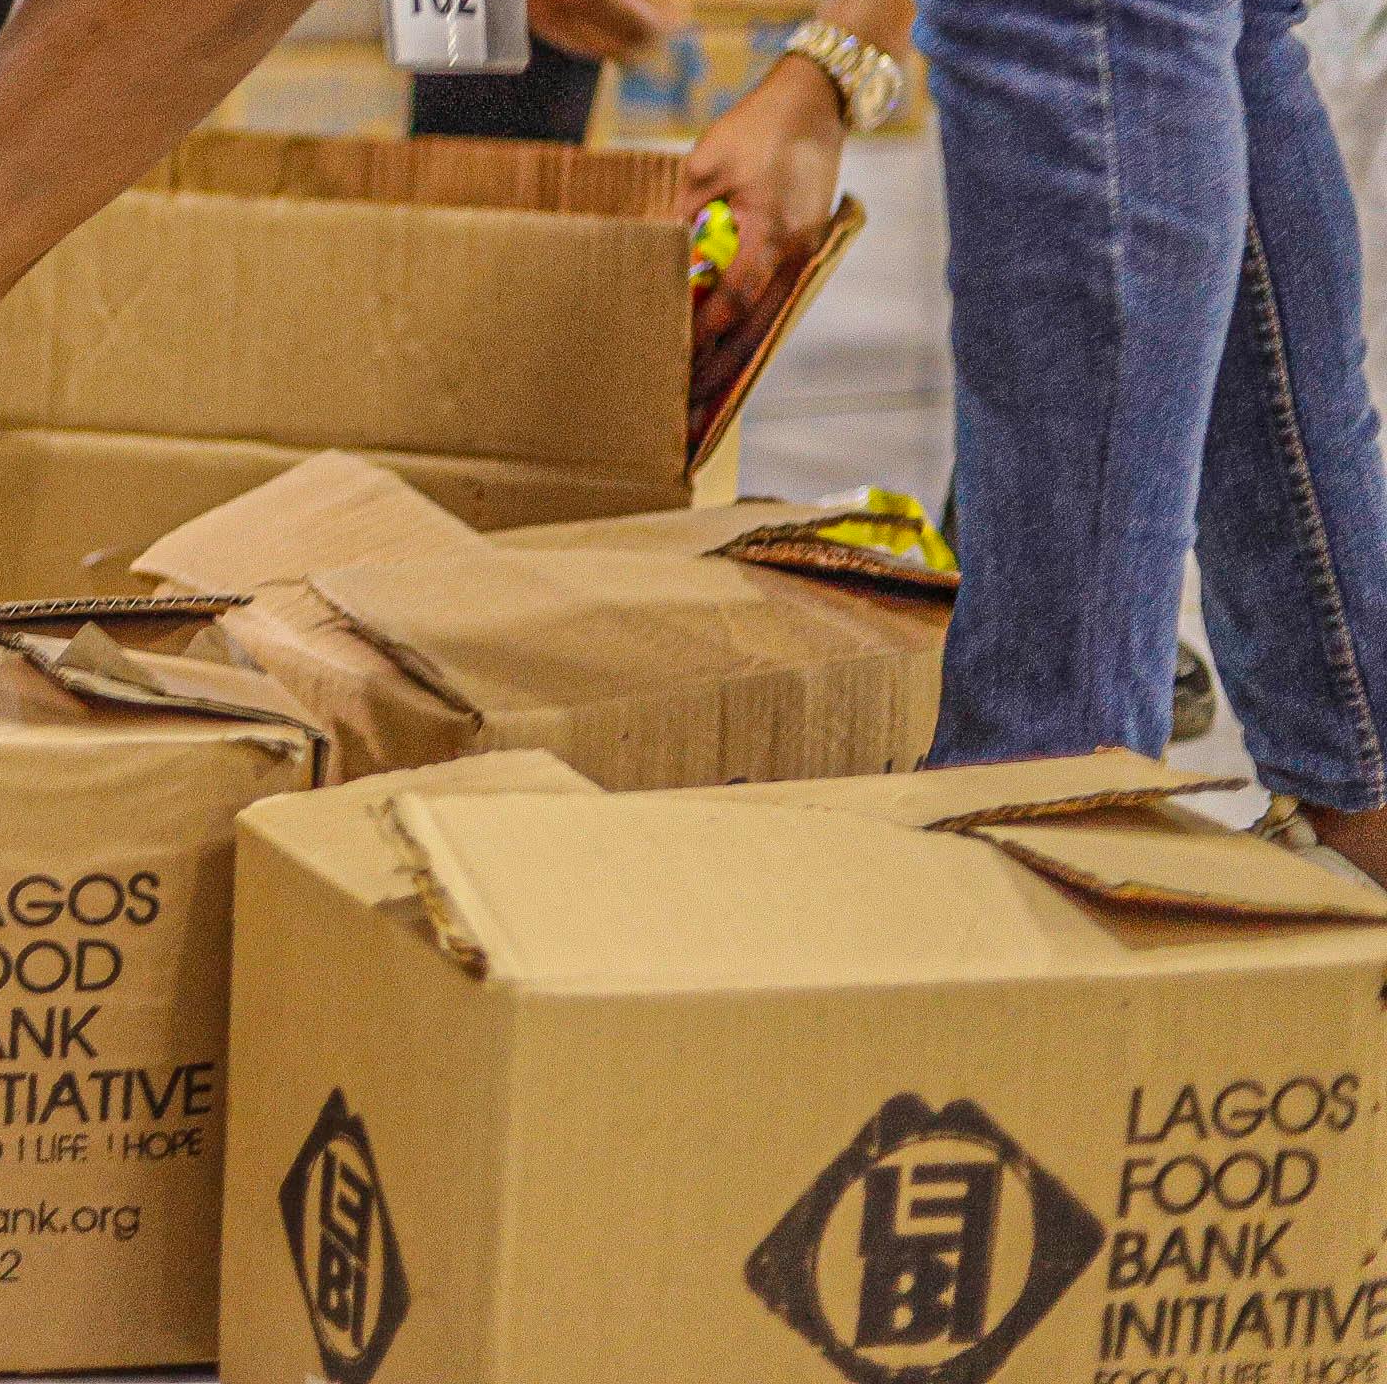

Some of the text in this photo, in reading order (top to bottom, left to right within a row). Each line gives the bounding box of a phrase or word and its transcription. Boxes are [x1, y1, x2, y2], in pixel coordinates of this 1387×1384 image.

[121, 1124, 204, 1162] HOPE
[1125, 1071, 1361, 1146] LAGOS
[1115, 1147, 1320, 1220] FOOD
[1106, 1218, 1293, 1291] BANK
[1098, 1276, 1387, 1362] INITIATIVE
